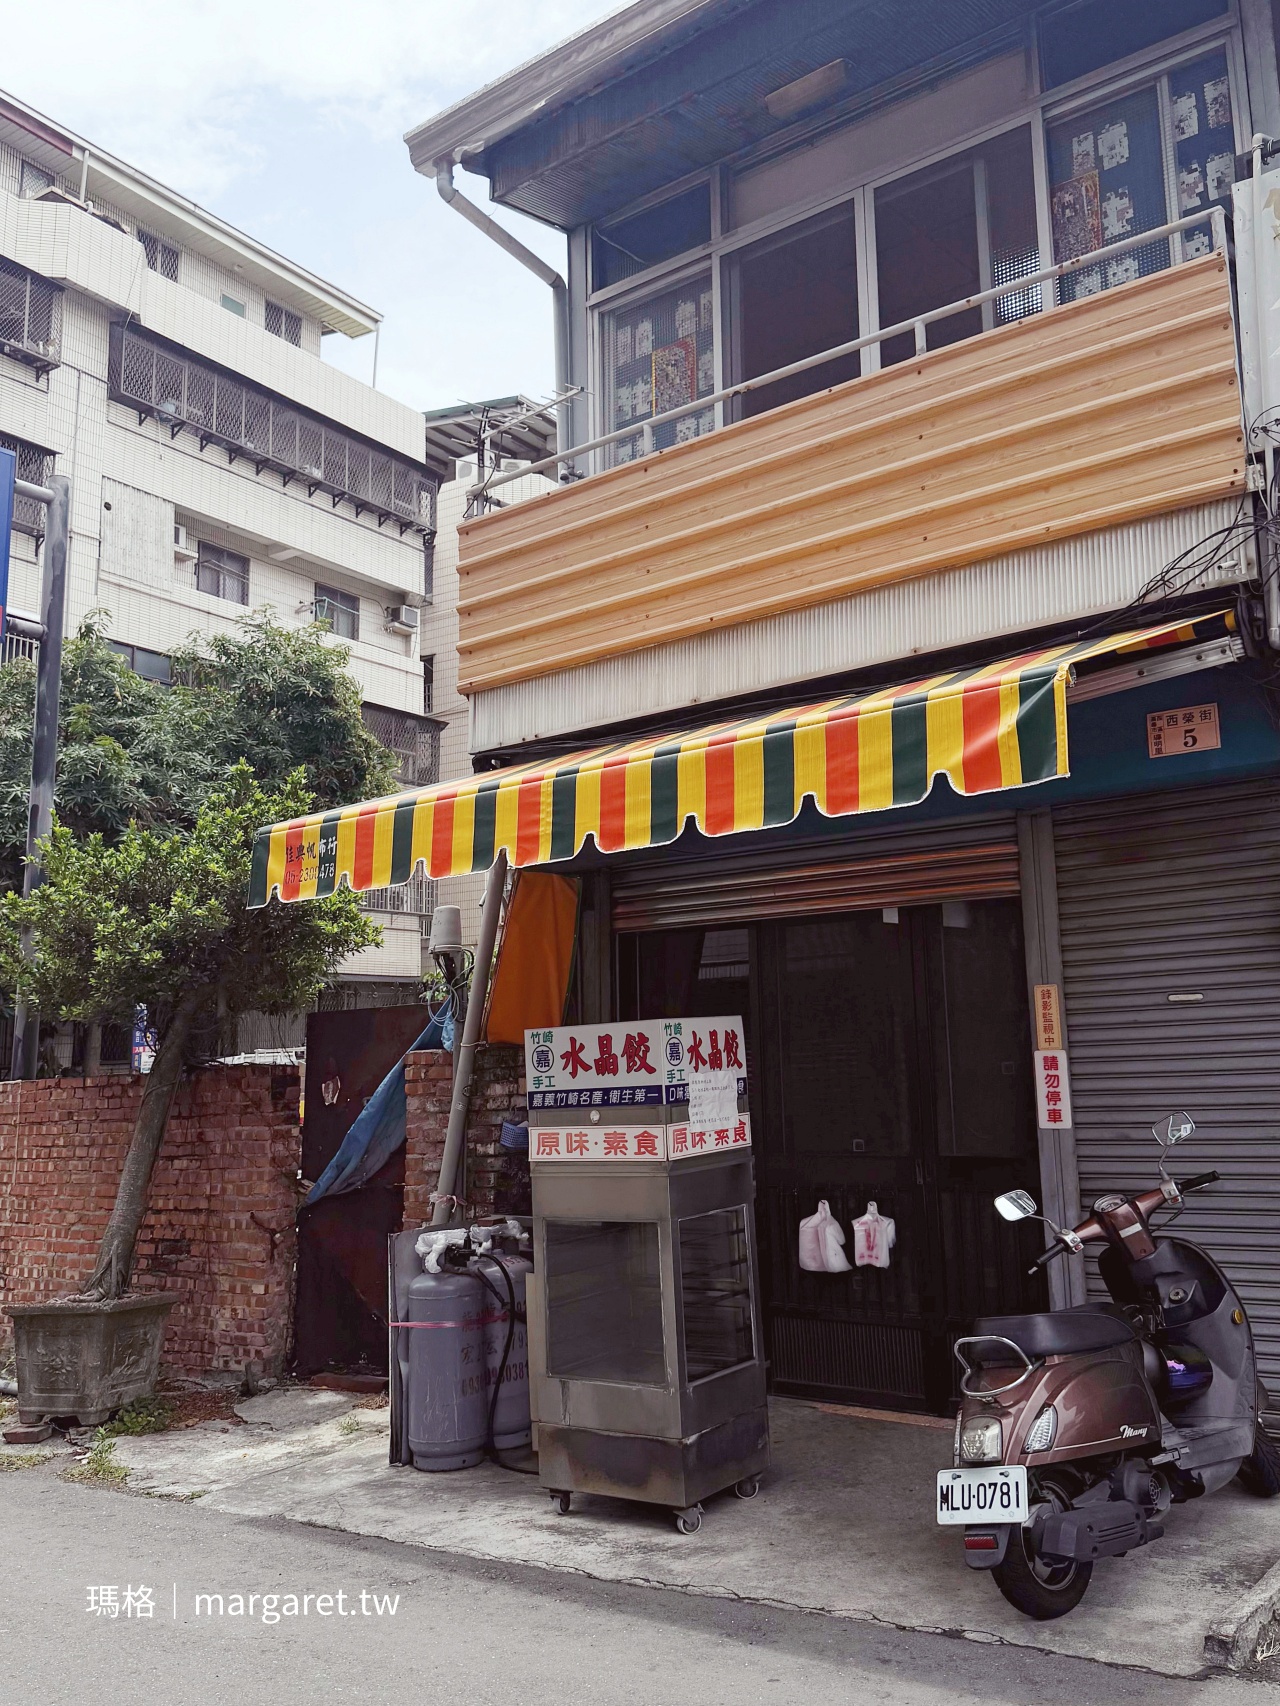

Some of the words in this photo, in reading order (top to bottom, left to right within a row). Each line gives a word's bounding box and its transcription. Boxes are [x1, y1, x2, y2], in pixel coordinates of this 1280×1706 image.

[1166, 709, 1212, 727] 西榮街
[1183, 728, 1198, 748] 5
[1040, 988, 1055, 1047] 錄影監視中
[530, 1030, 554, 1045] 竹崎
[664, 1022, 683, 1037] 竹崎
[535, 1049, 551, 1069] 嘉
[560, 1031, 657, 1079] 水晶餃
[668, 1041, 681, 1061] 嘉
[686, 1028, 743, 1073] 水晶餃
[532, 1075, 556, 1089] 手工
[666, 1068, 686, 1083] 手工
[1042, 1055, 1063, 1124] 請勿停車
[1119, 1424, 1148, 1439] Many
